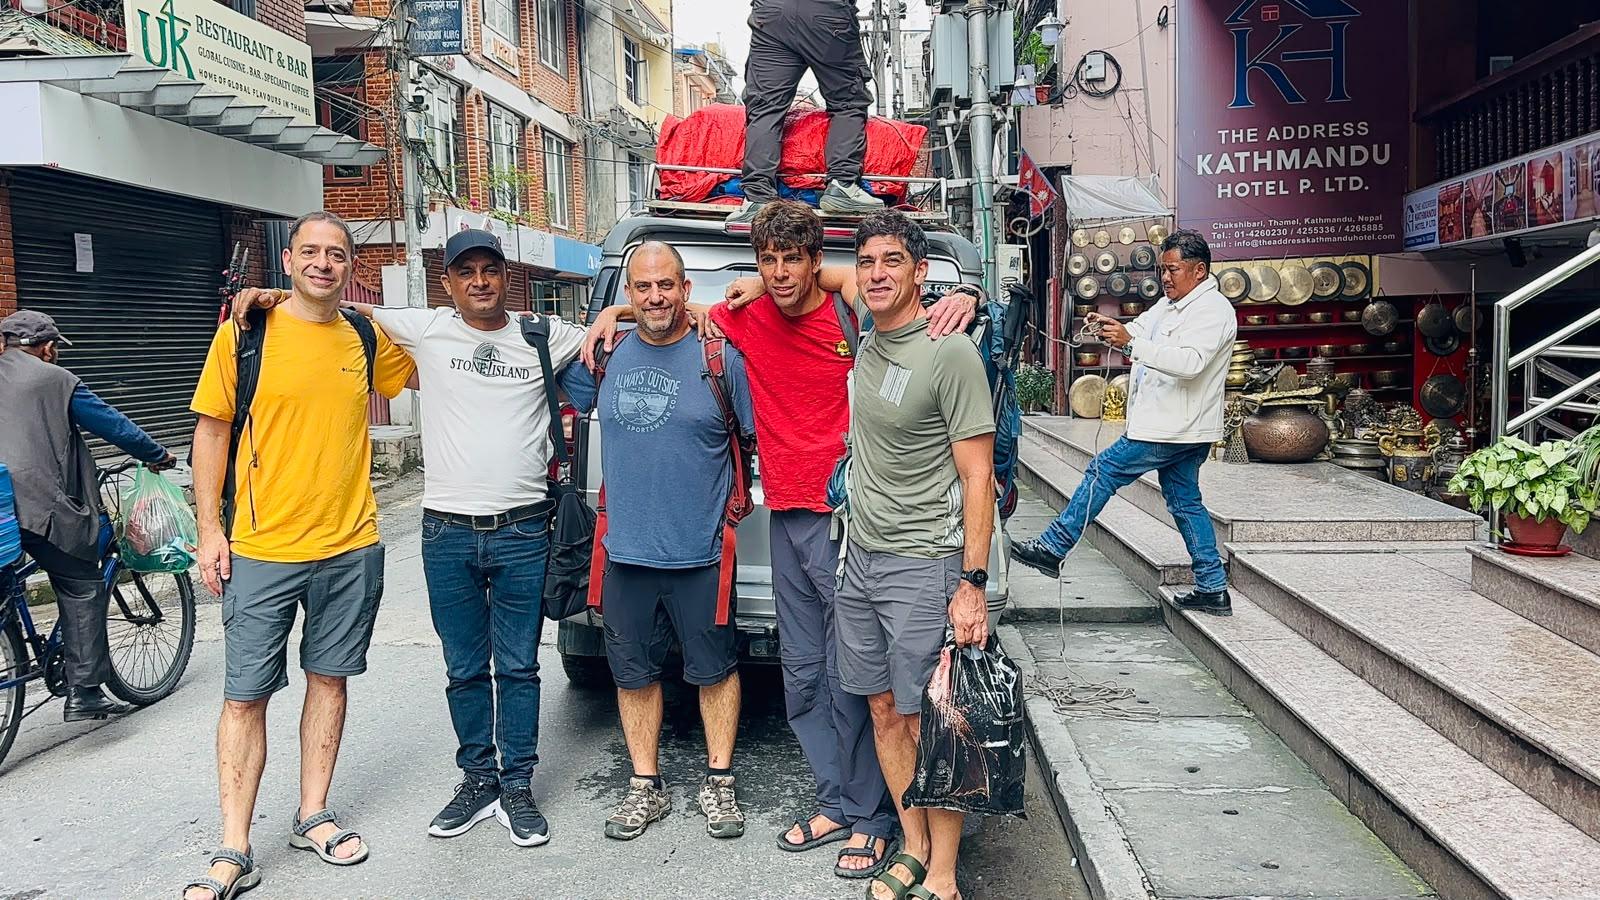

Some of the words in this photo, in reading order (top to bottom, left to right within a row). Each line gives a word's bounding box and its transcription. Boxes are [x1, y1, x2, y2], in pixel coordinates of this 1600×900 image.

[195, 14, 274, 64] RESTAURANT
[276, 51, 286, 69] &
[287, 54, 309, 79] BAR
[198, 46, 223, 64] GLOBAL
[249, 66, 262, 79] BAR
[264, 72, 291, 91] SPECIALTY
[291, 83, 310, 98] COFFEE
[198, 68, 217, 83] HOME
[218, 75, 227, 86] OF
[227, 79, 251, 95] GLOBAL
[252, 88, 281, 106] FLAVOURS
[283, 99, 289, 108] IN
[291, 102, 311, 117] THAMEL
[1217, 127, 1258, 145] THE
[1266, 121, 1369, 142] ADDRESS
[1196, 143, 1391, 176] KATHMANDU
[1217, 180, 1289, 199] HOTEL
[1299, 178, 1315, 194] P.
[1325, 176, 1369, 193] LTD.
[1211, 231, 1232, 240] Tel.:
[1234, 228, 1288, 239] 01-4260230
[1296, 226, 1336, 235] 4255336
[1344, 223, 1384, 233] 4265885
[1212, 220, 1266, 230] Chakshibari,
[1268, 218, 1302, 227] Thamel,
[1304, 216, 1356, 225] Kathmandu,
[1358, 214, 1383, 223] Nepal
[1208, 241, 1227, 249] mail
[1234, 233, 1396, 248] info@theaddresskathmanduhotel.com
[450, 357, 488, 376] STONE
[492, 364, 530, 380] ISLAND
[614, 370, 647, 389] ALWAYS
[647, 370, 682, 396] OUTSIDE
[611, 390, 625, 426] COLUMBIA
[626, 411, 672, 433] SPORTSWEAR
[669, 396, 678, 410] CO.
